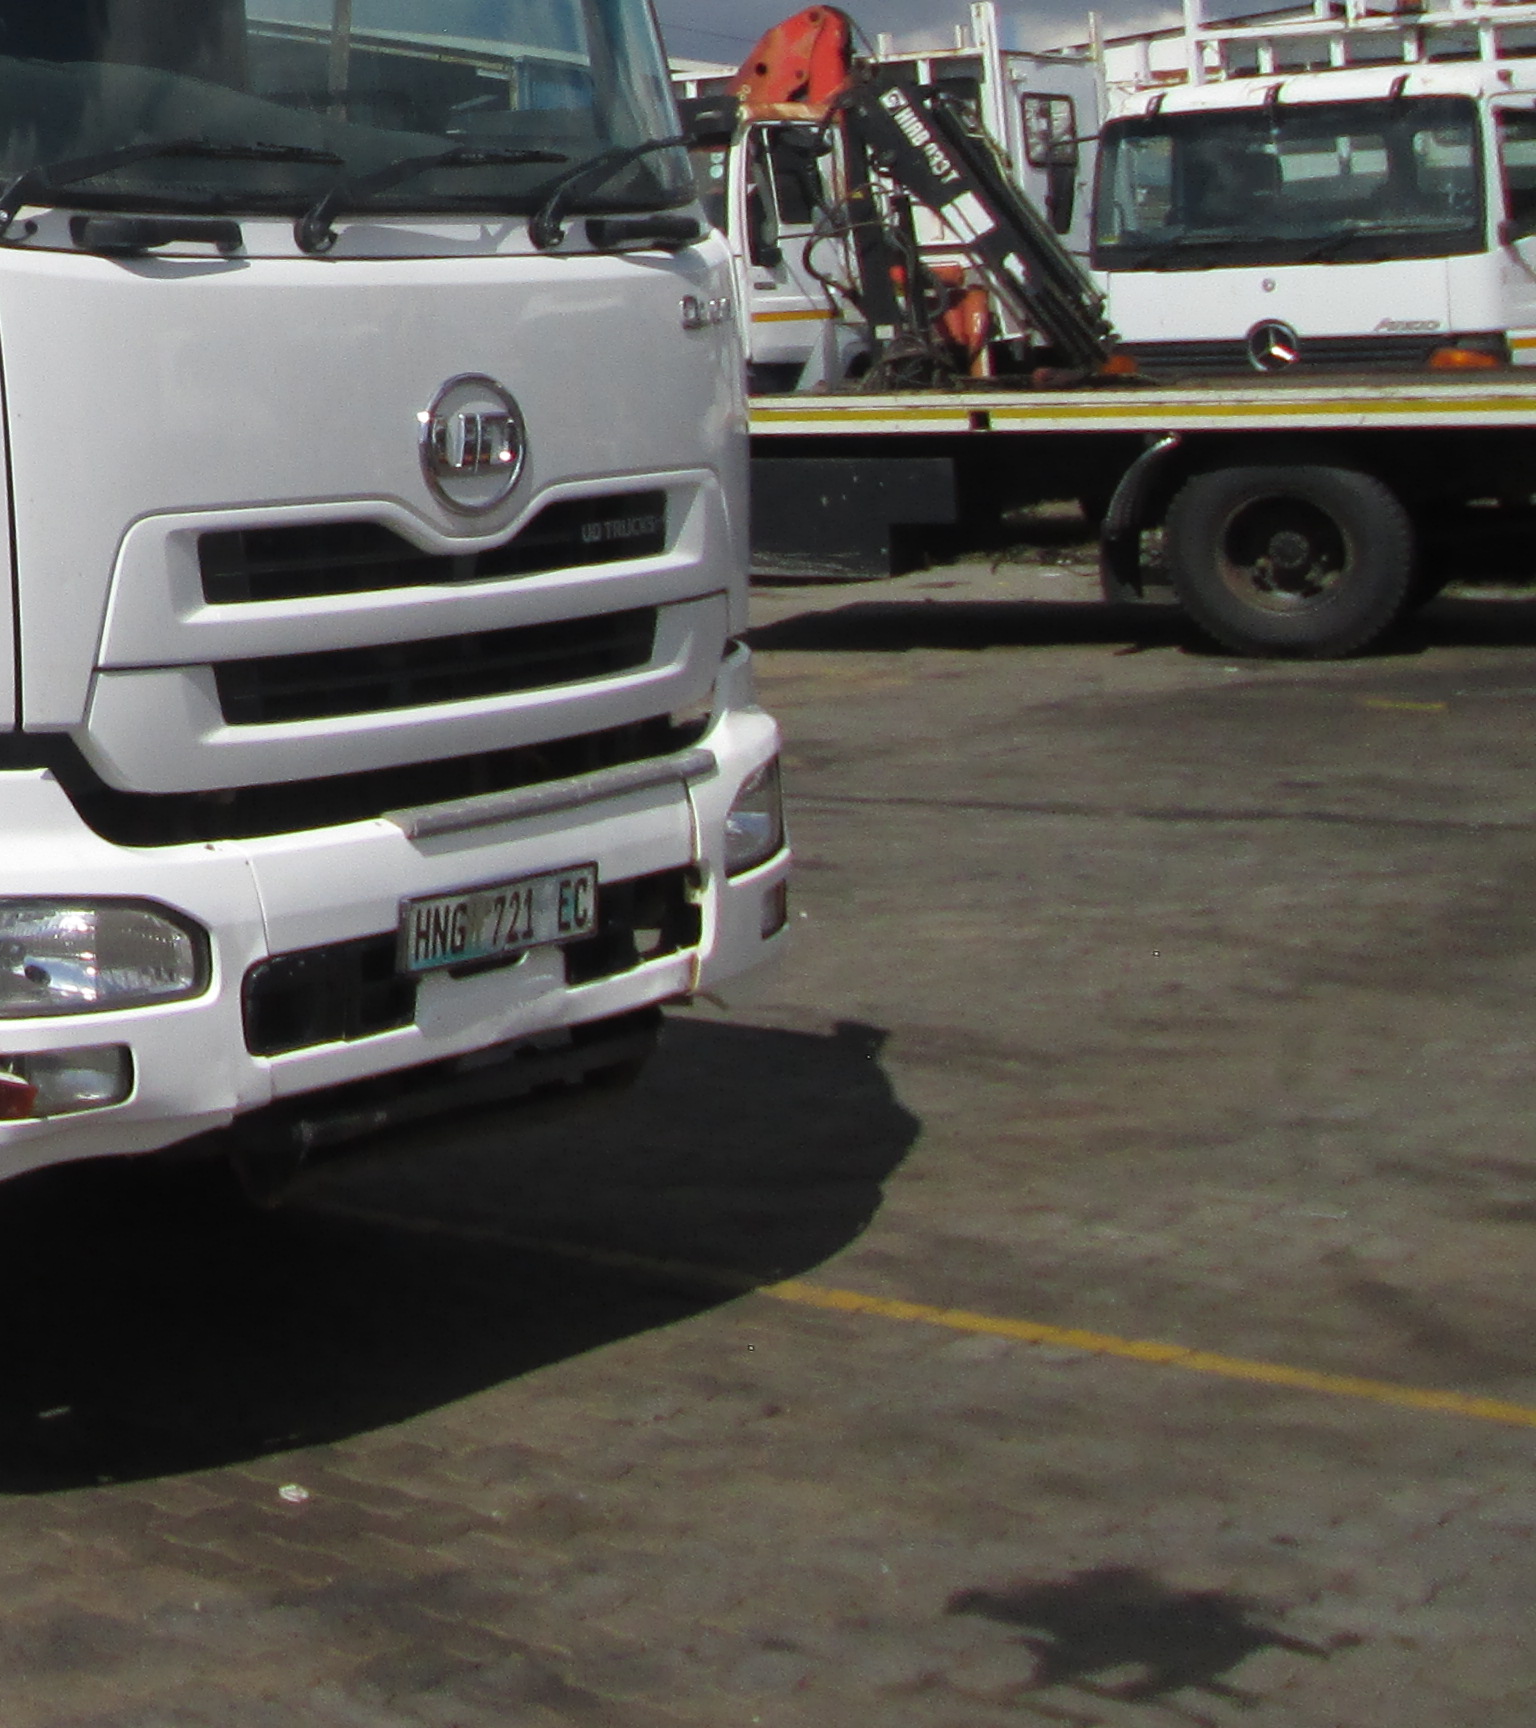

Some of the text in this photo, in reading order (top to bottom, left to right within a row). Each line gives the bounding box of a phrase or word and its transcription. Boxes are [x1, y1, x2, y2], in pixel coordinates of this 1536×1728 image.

[893, 106, 931, 147] HIAB
[581, 515, 660, 543] UD TRUCKS
[415, 876, 588, 962] HNG 721 EC
